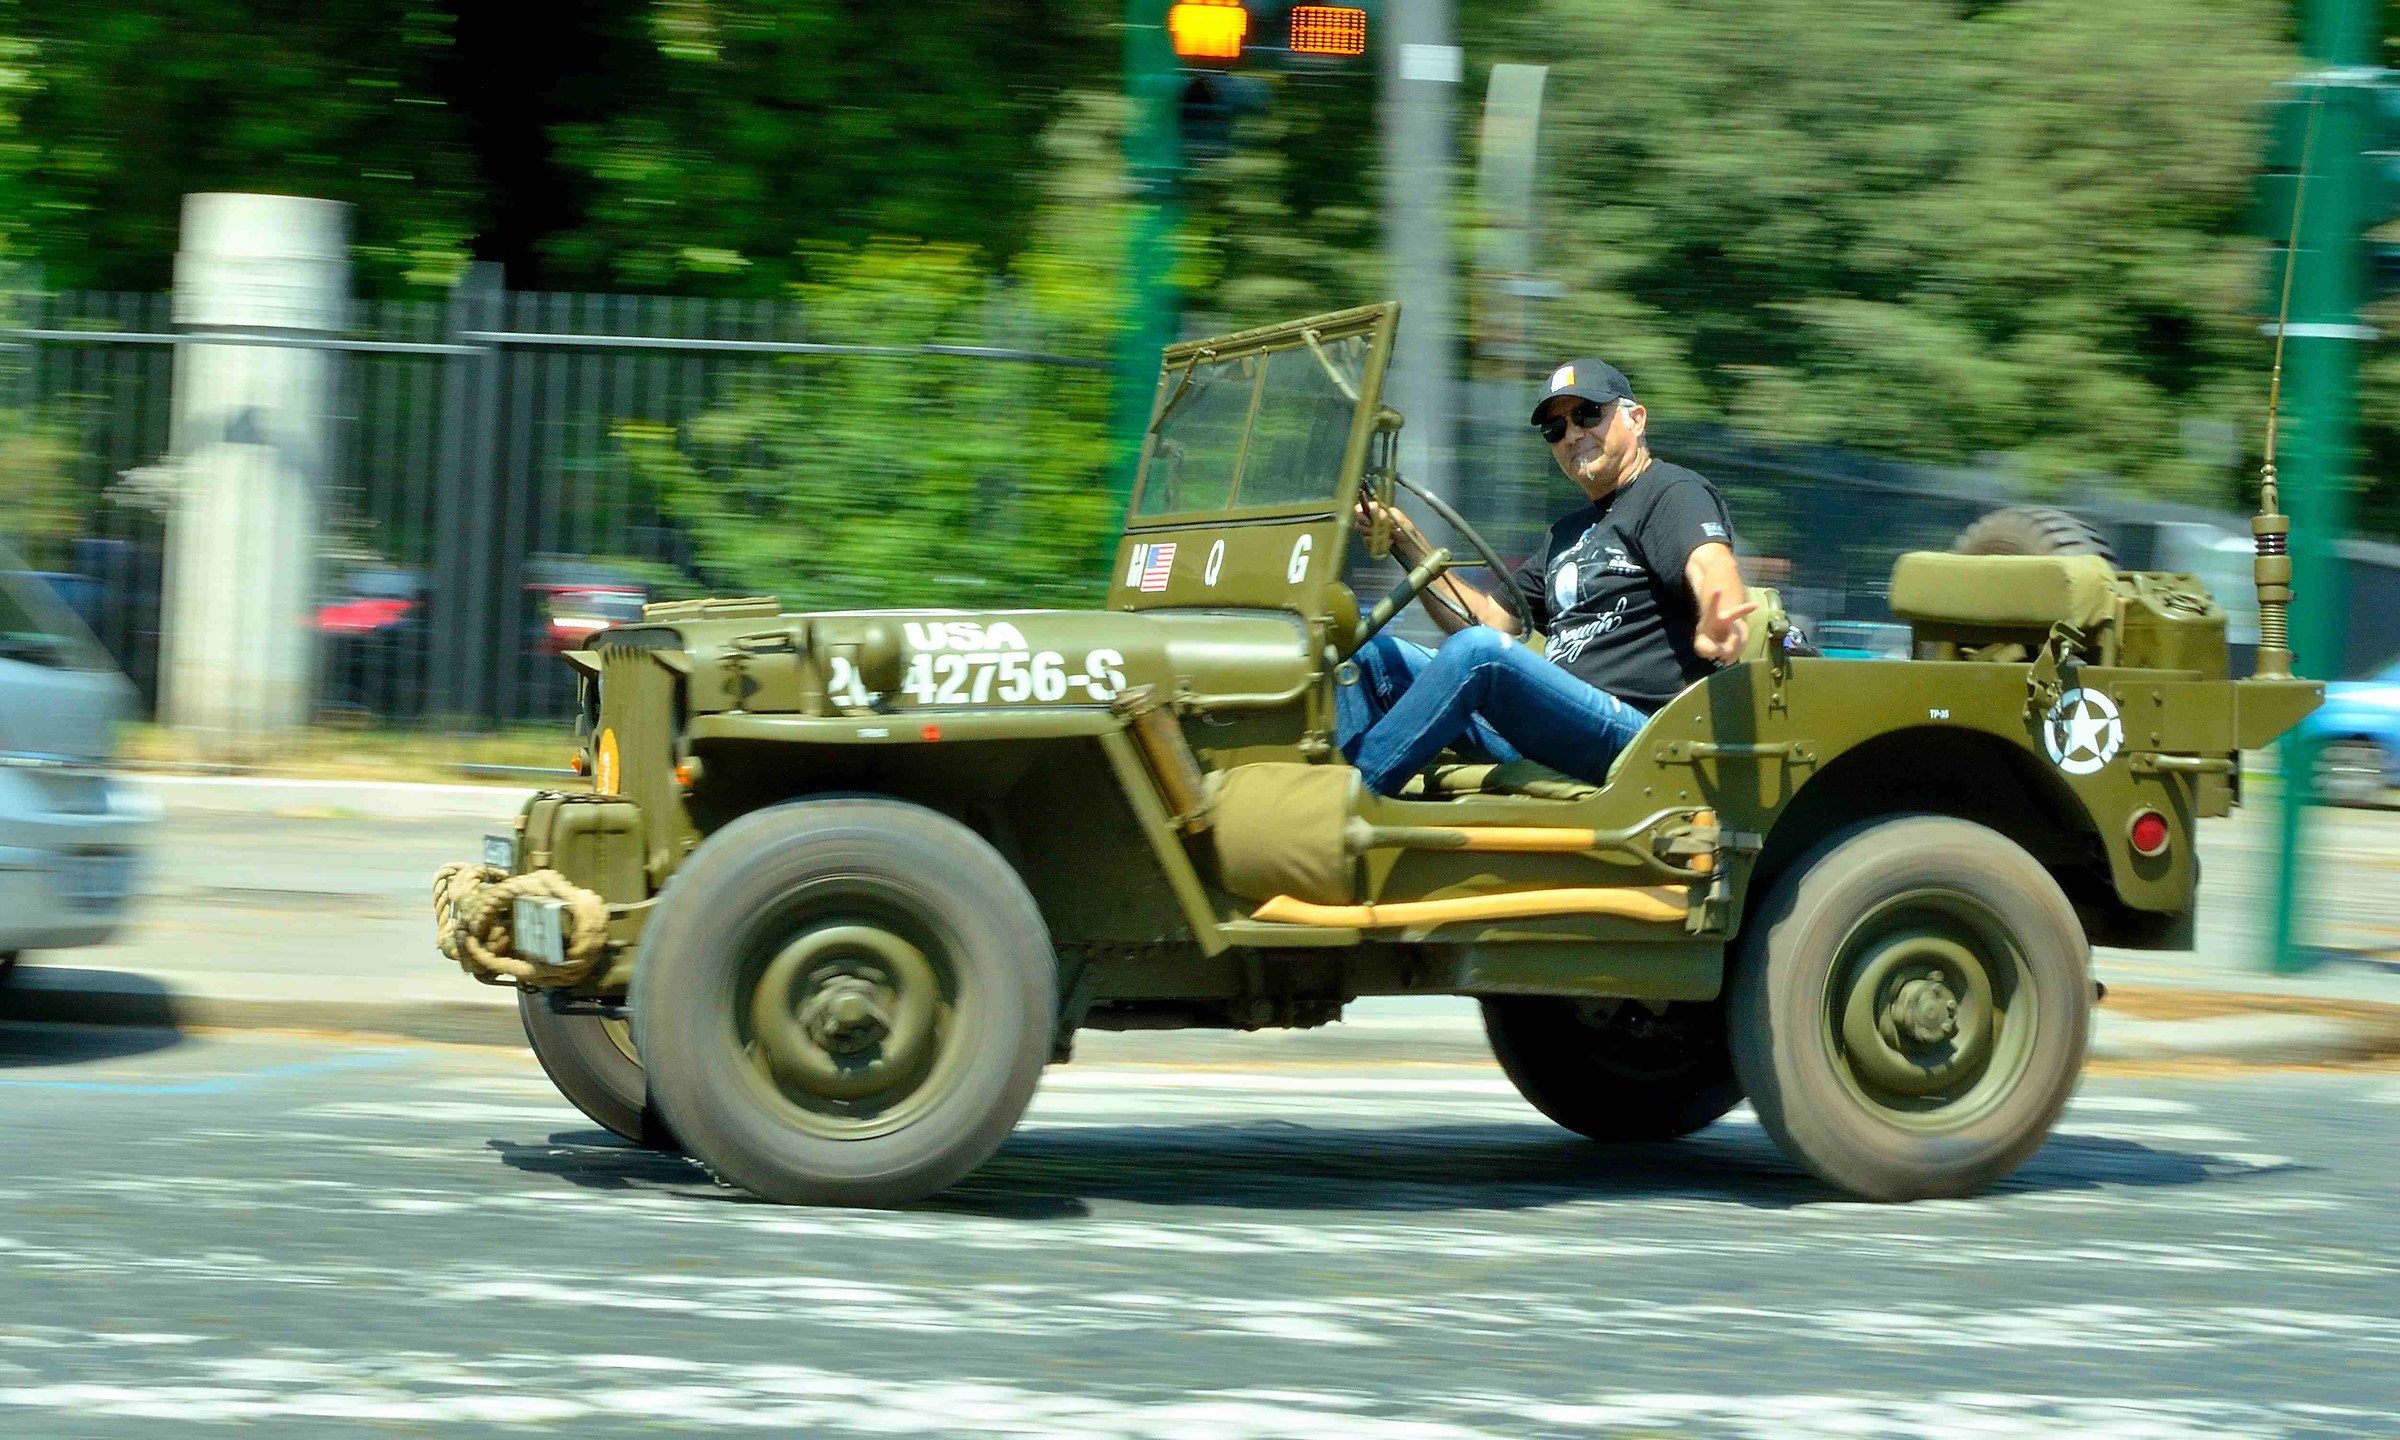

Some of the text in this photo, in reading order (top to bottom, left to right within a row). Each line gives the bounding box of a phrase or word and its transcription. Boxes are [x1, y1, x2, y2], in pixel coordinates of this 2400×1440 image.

[1204, 538, 1225, 587] Q
[1286, 533, 1313, 585] G
[903, 621, 1029, 651] USA
